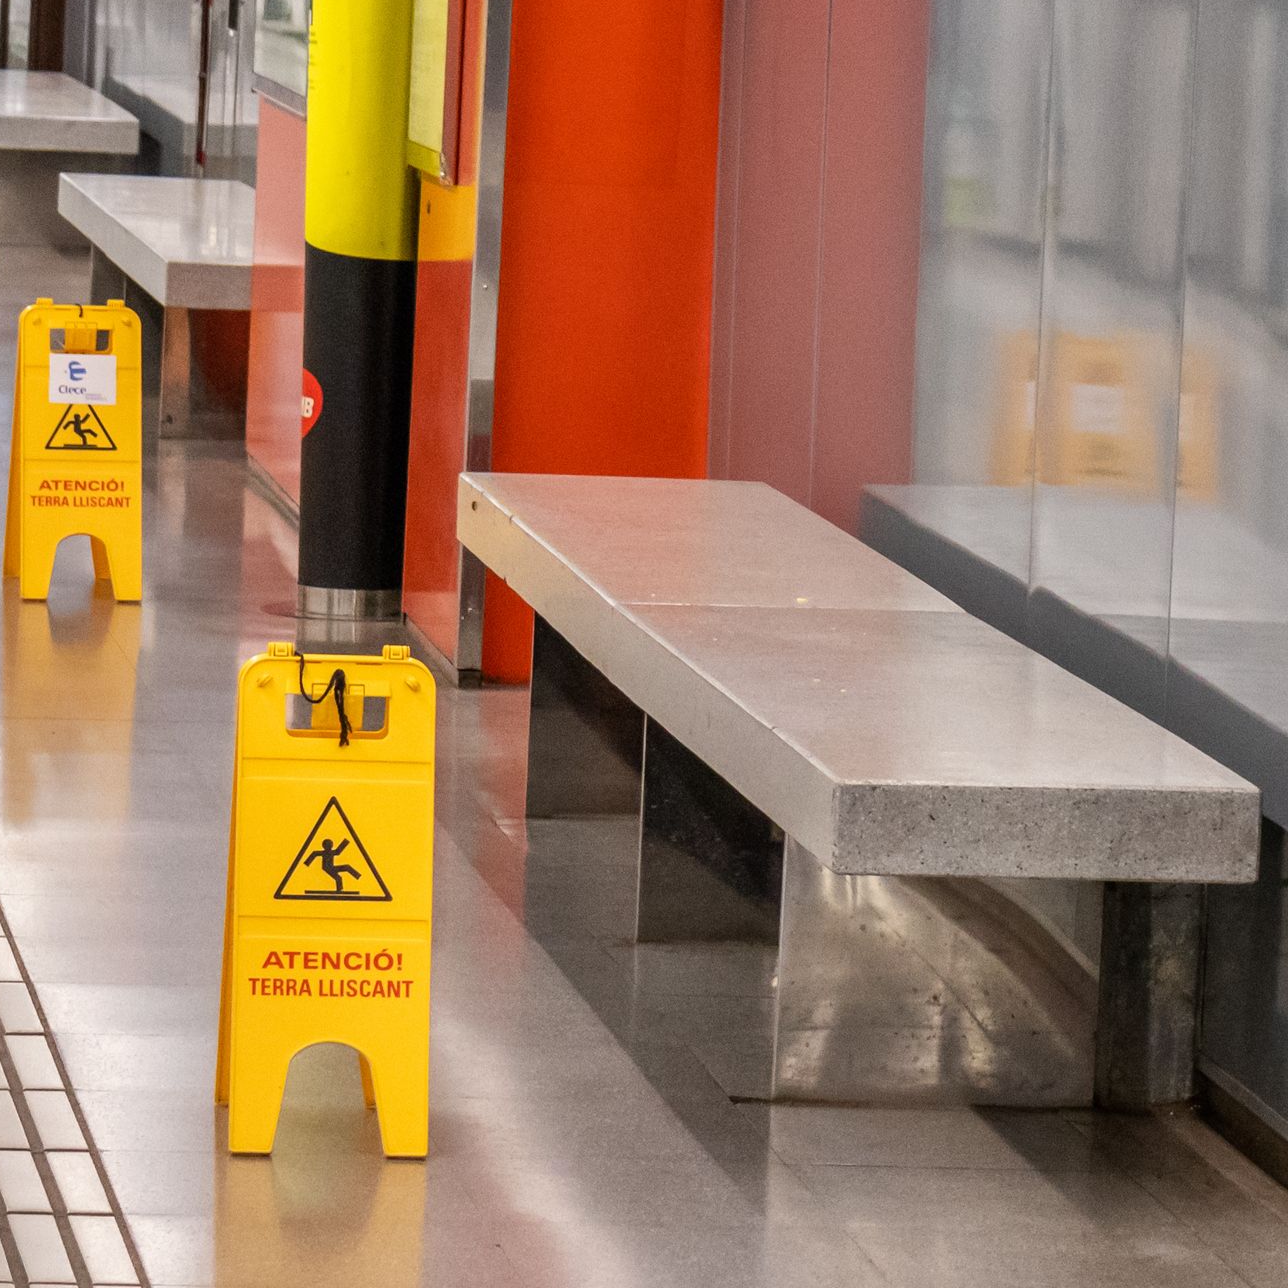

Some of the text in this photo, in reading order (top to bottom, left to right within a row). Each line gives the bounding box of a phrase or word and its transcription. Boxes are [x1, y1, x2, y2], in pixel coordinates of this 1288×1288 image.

[39, 478, 125, 492] ATENCIÓ!
[30, 495, 131, 509] TERRA LLISCANT
[262, 947, 404, 972] ATENCIÓ!
[248, 976, 414, 999] TERRA LLISCANT
